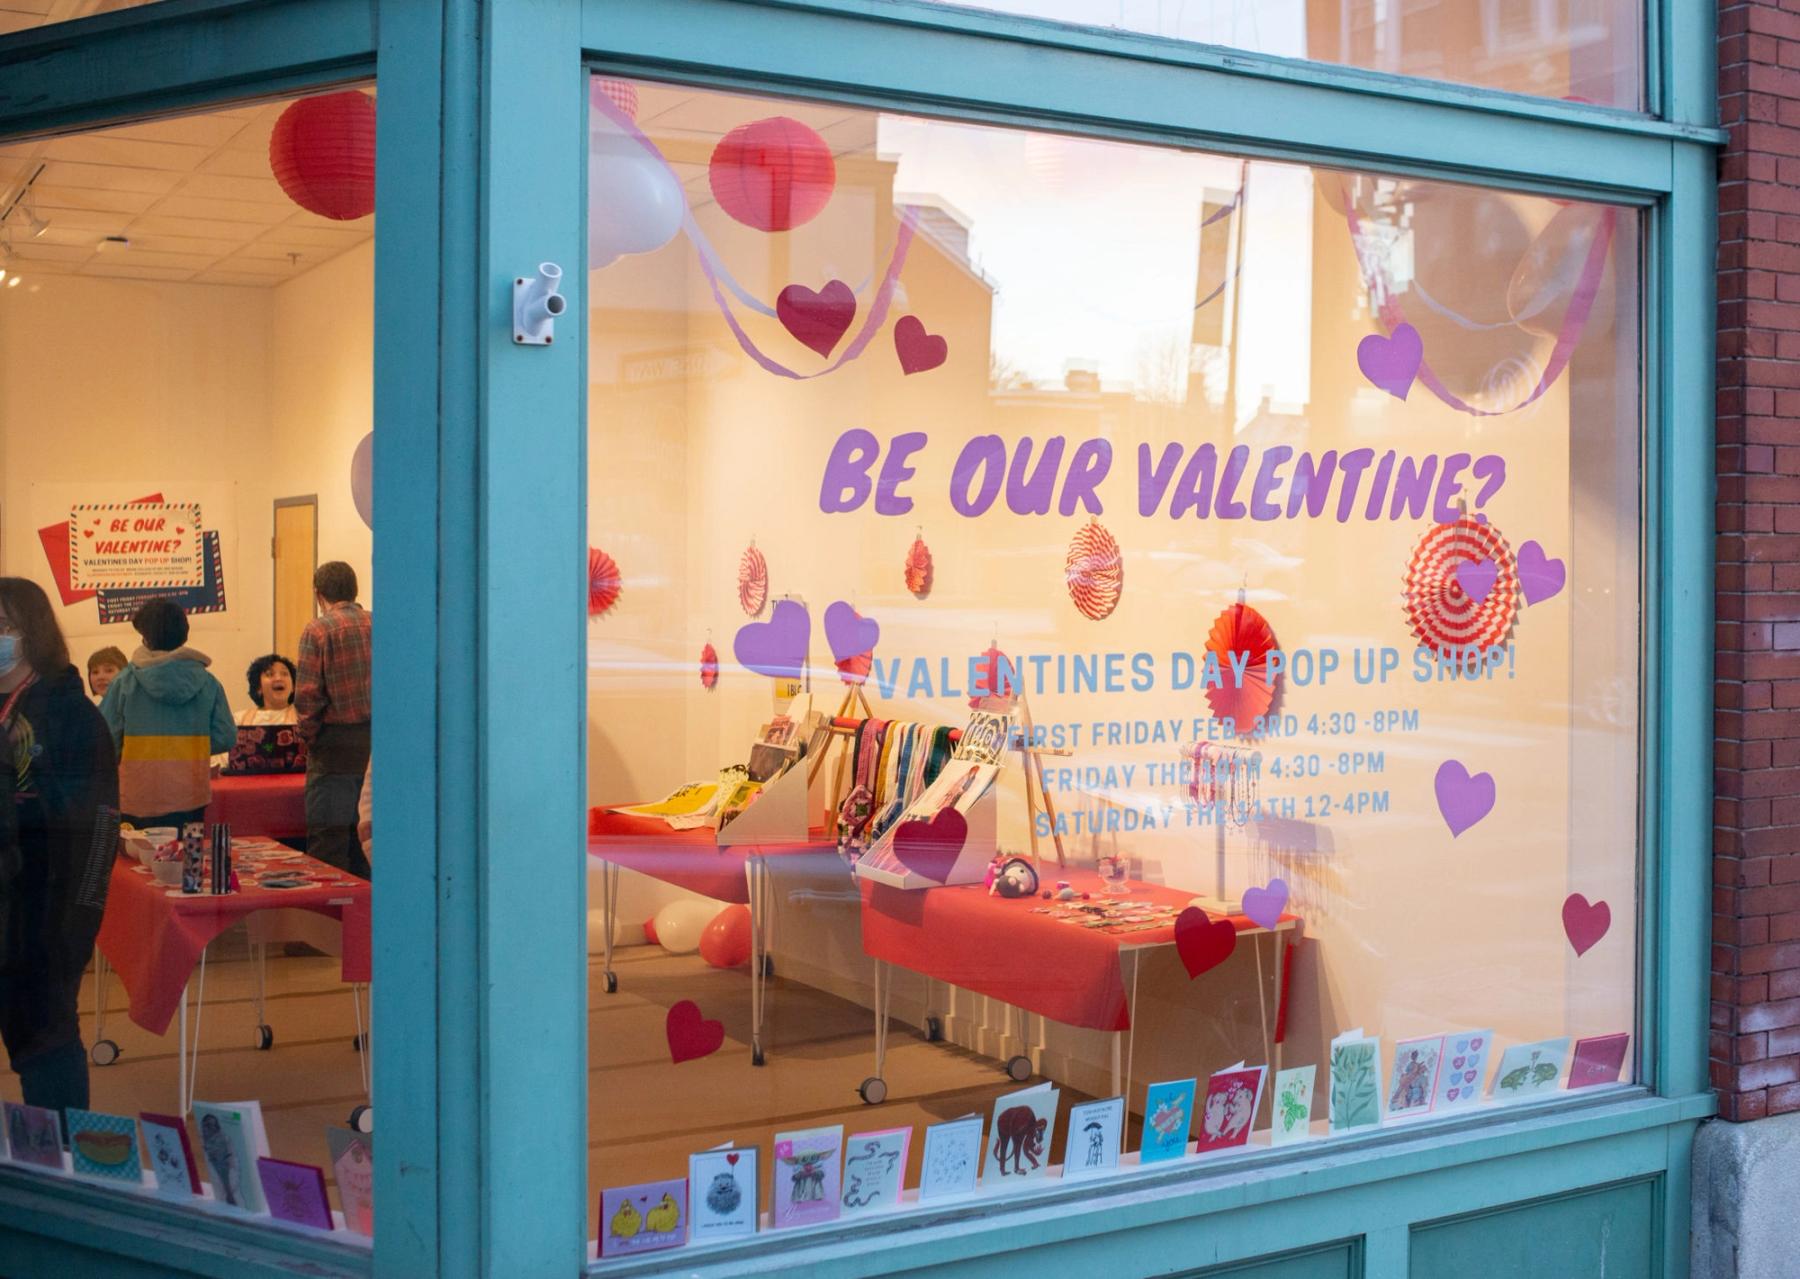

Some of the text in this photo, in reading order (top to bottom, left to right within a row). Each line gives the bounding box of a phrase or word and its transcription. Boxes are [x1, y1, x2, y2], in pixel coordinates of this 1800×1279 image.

[819, 428, 1506, 524] BE OUR VALENTINE?
[110, 518, 166, 532] BE OUR
[83, 558, 127, 566] VALENTINES
[128, 557, 143, 565] DAY
[95, 540, 182, 554] VALENTINE?
[873, 645, 1516, 700] VALENTINES DAY POP UP SHOP!
[1007, 708, 1419, 749] FIRST FRIDAY FEB. 3RD 4:30 -8PM
[1042, 751, 1385, 793] FRIDAY THE 10TH 4:30 -8PM
[1036, 790, 1390, 838] SATURDAY THE 11TH 12-4PM
